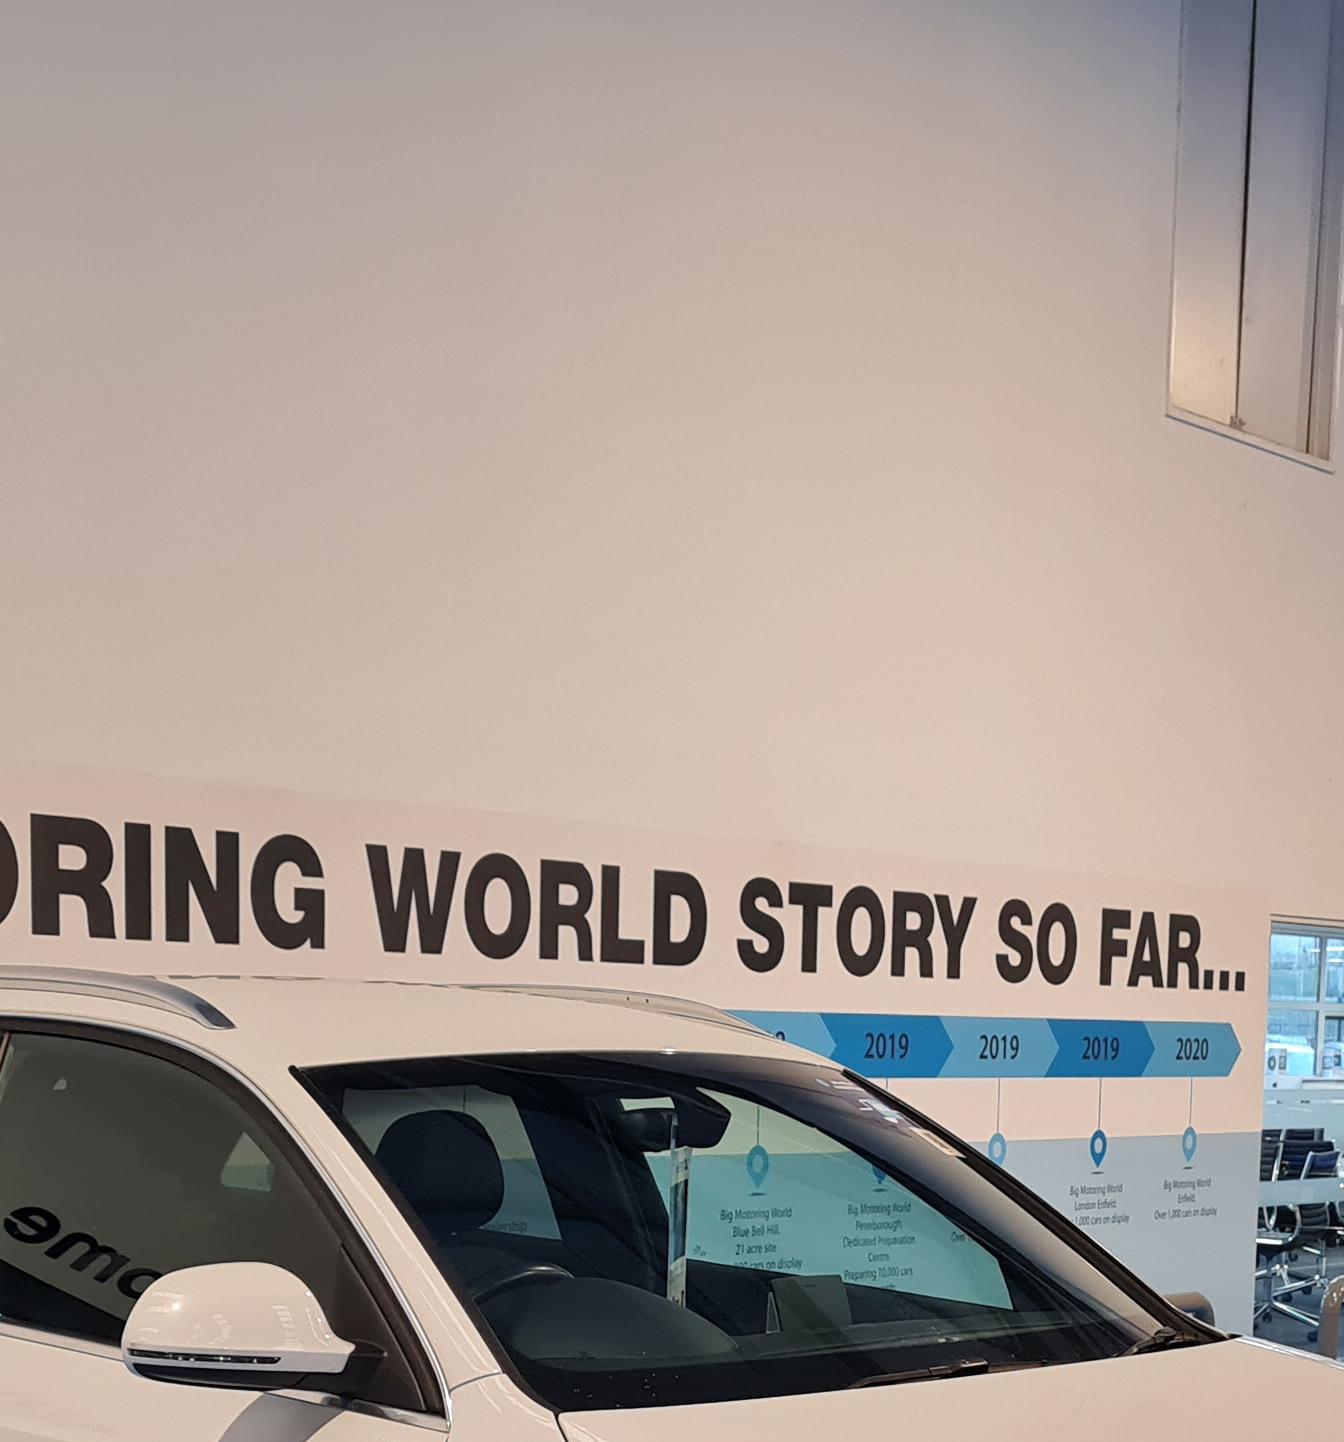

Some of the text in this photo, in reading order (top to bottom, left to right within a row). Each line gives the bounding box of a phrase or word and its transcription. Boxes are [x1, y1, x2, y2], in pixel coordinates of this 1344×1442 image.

[365, 842, 707, 967] WORLD
[736, 876, 978, 980] STORY
[995, 898, 1078, 986] SO
[1099, 907, 1246, 992] FAR...
[864, 1032, 910, 1059] 2019
[979, 1034, 1020, 1060] 2019
[1082, 1036, 1120, 1061] 2019
[1175, 1037, 1209, 1061] 2020
[1069, 1183, 1123, 1198] Big Motoring World
[1163, 1178, 1212, 1193] Big Motoring World
[847, 1203, 911, 1218] Big Motoring World
[1074, 1200, 1096, 1212] London
[720, 1206, 792, 1223] Big Motoring World
[1091, 1216, 1102, 1226] cars
[1103, 1216, 1111, 1225] on
[1111, 1213, 1130, 1226] display
[1154, 1209, 1167, 1220] Over
[1200, 1207, 1218, 1218] display
[733, 1226, 749, 1238] Blue
[751, 1225, 765, 1237] Bell
[843, 1235, 916, 1248] Dedicated Preparation
[735, 1243, 777, 1256] 21 acre site
[766, 1261, 777, 1269] on
[777, 1257, 803, 1271] display
[868, 1251, 890, 1263] Centre
[844, 1268, 877, 1281] Preparing
